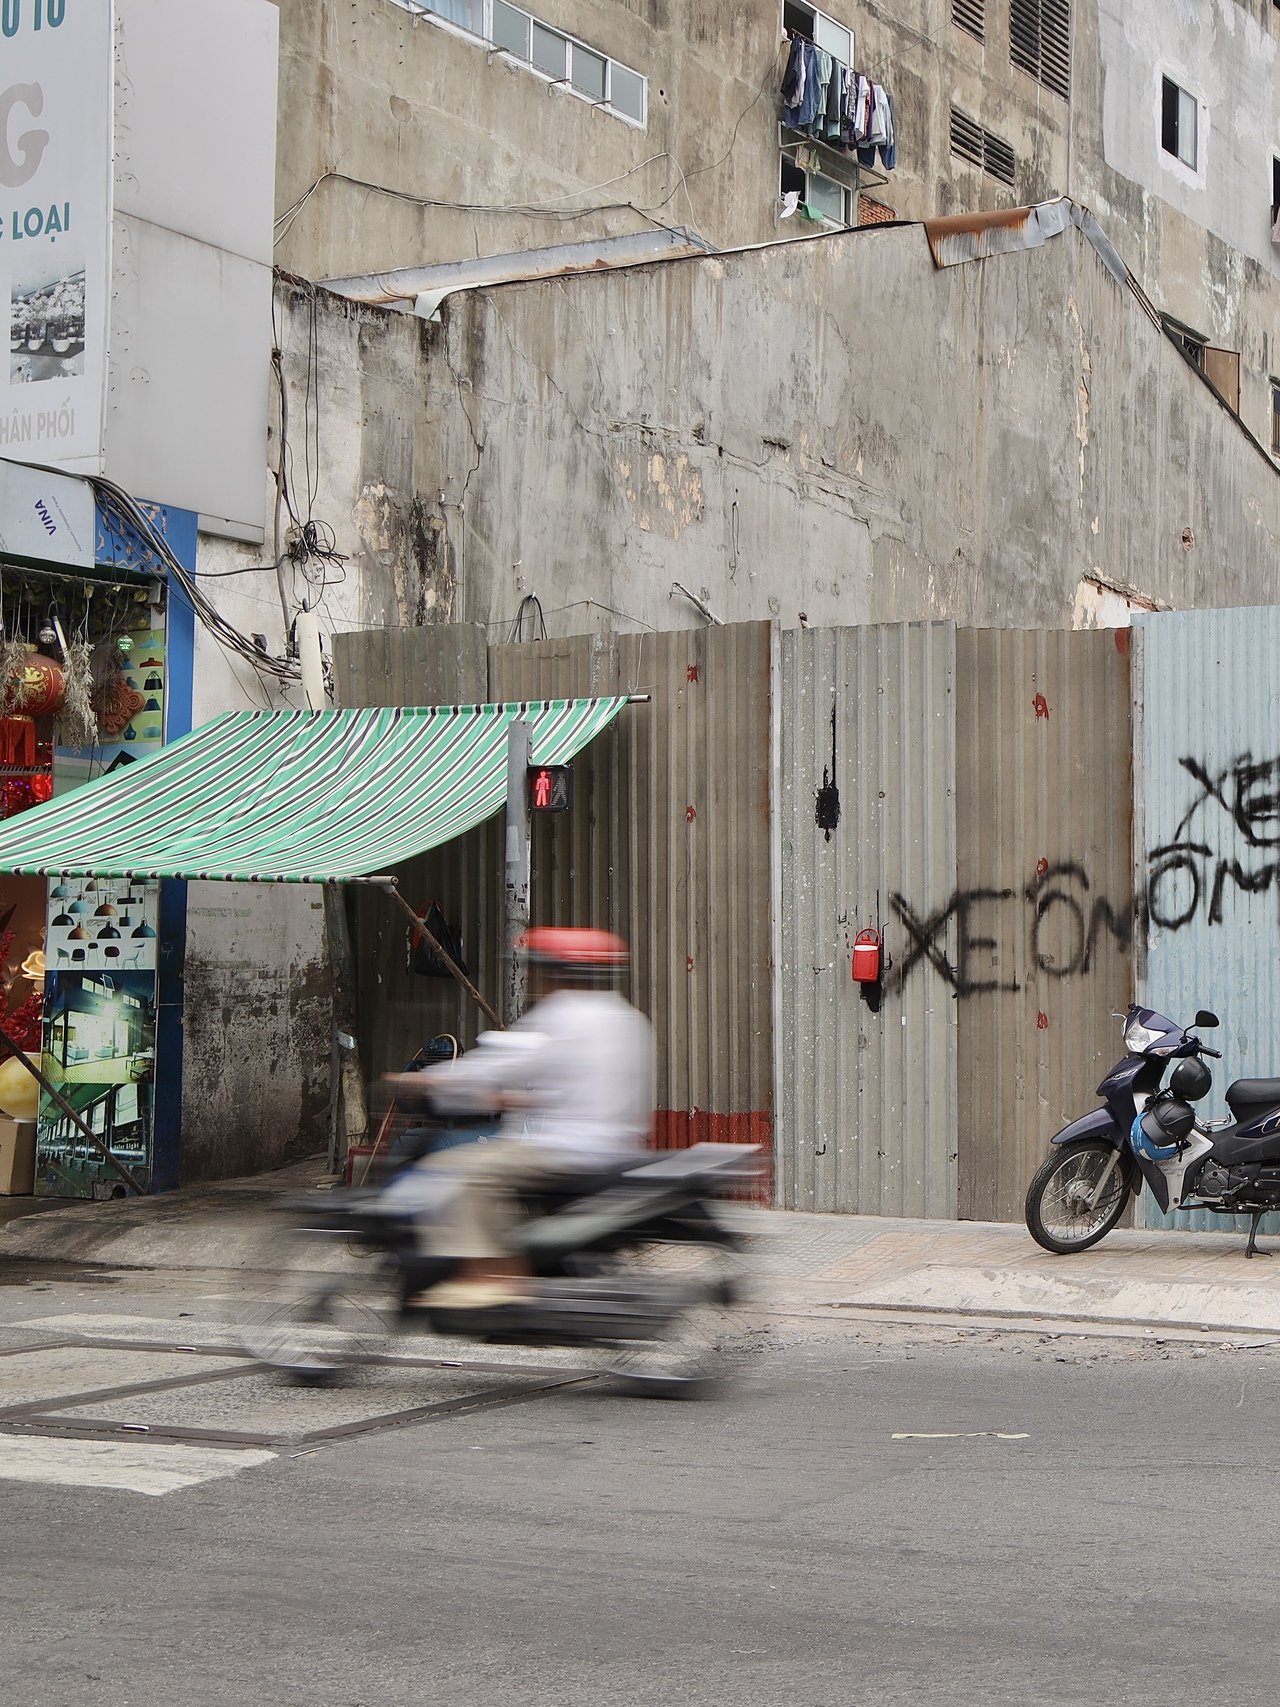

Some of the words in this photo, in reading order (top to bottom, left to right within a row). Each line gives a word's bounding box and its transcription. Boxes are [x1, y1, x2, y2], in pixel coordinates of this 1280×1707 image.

[12, 202, 70, 243] LOẠI
[36, 395, 75, 441] PHỐI
[34, 499, 57, 536] VINA
